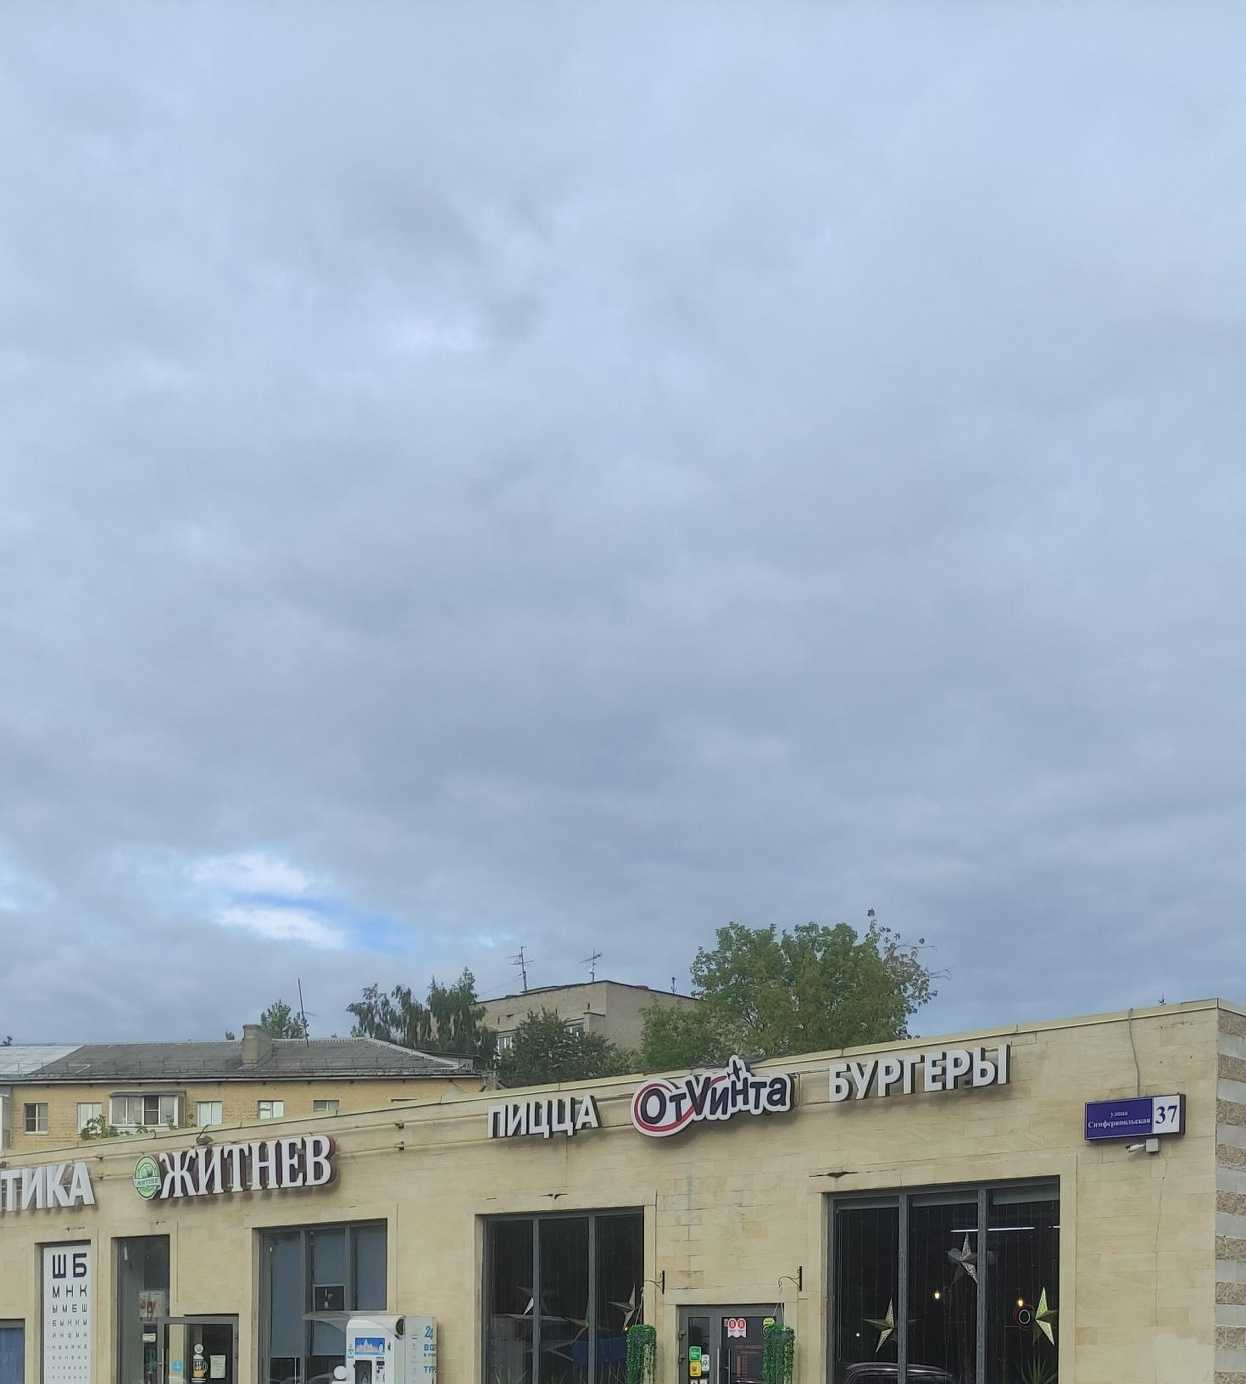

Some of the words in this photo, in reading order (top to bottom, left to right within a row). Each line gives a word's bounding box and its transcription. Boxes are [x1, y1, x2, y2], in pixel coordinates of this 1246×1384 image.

[829, 1044, 1010, 1102] БУРГЕРЫ
[487, 1095, 599, 1139] ПИЦЦА
[1155, 1105, 1178, 1124] 37
[159, 1135, 332, 1199] ЖИТНЕВ
